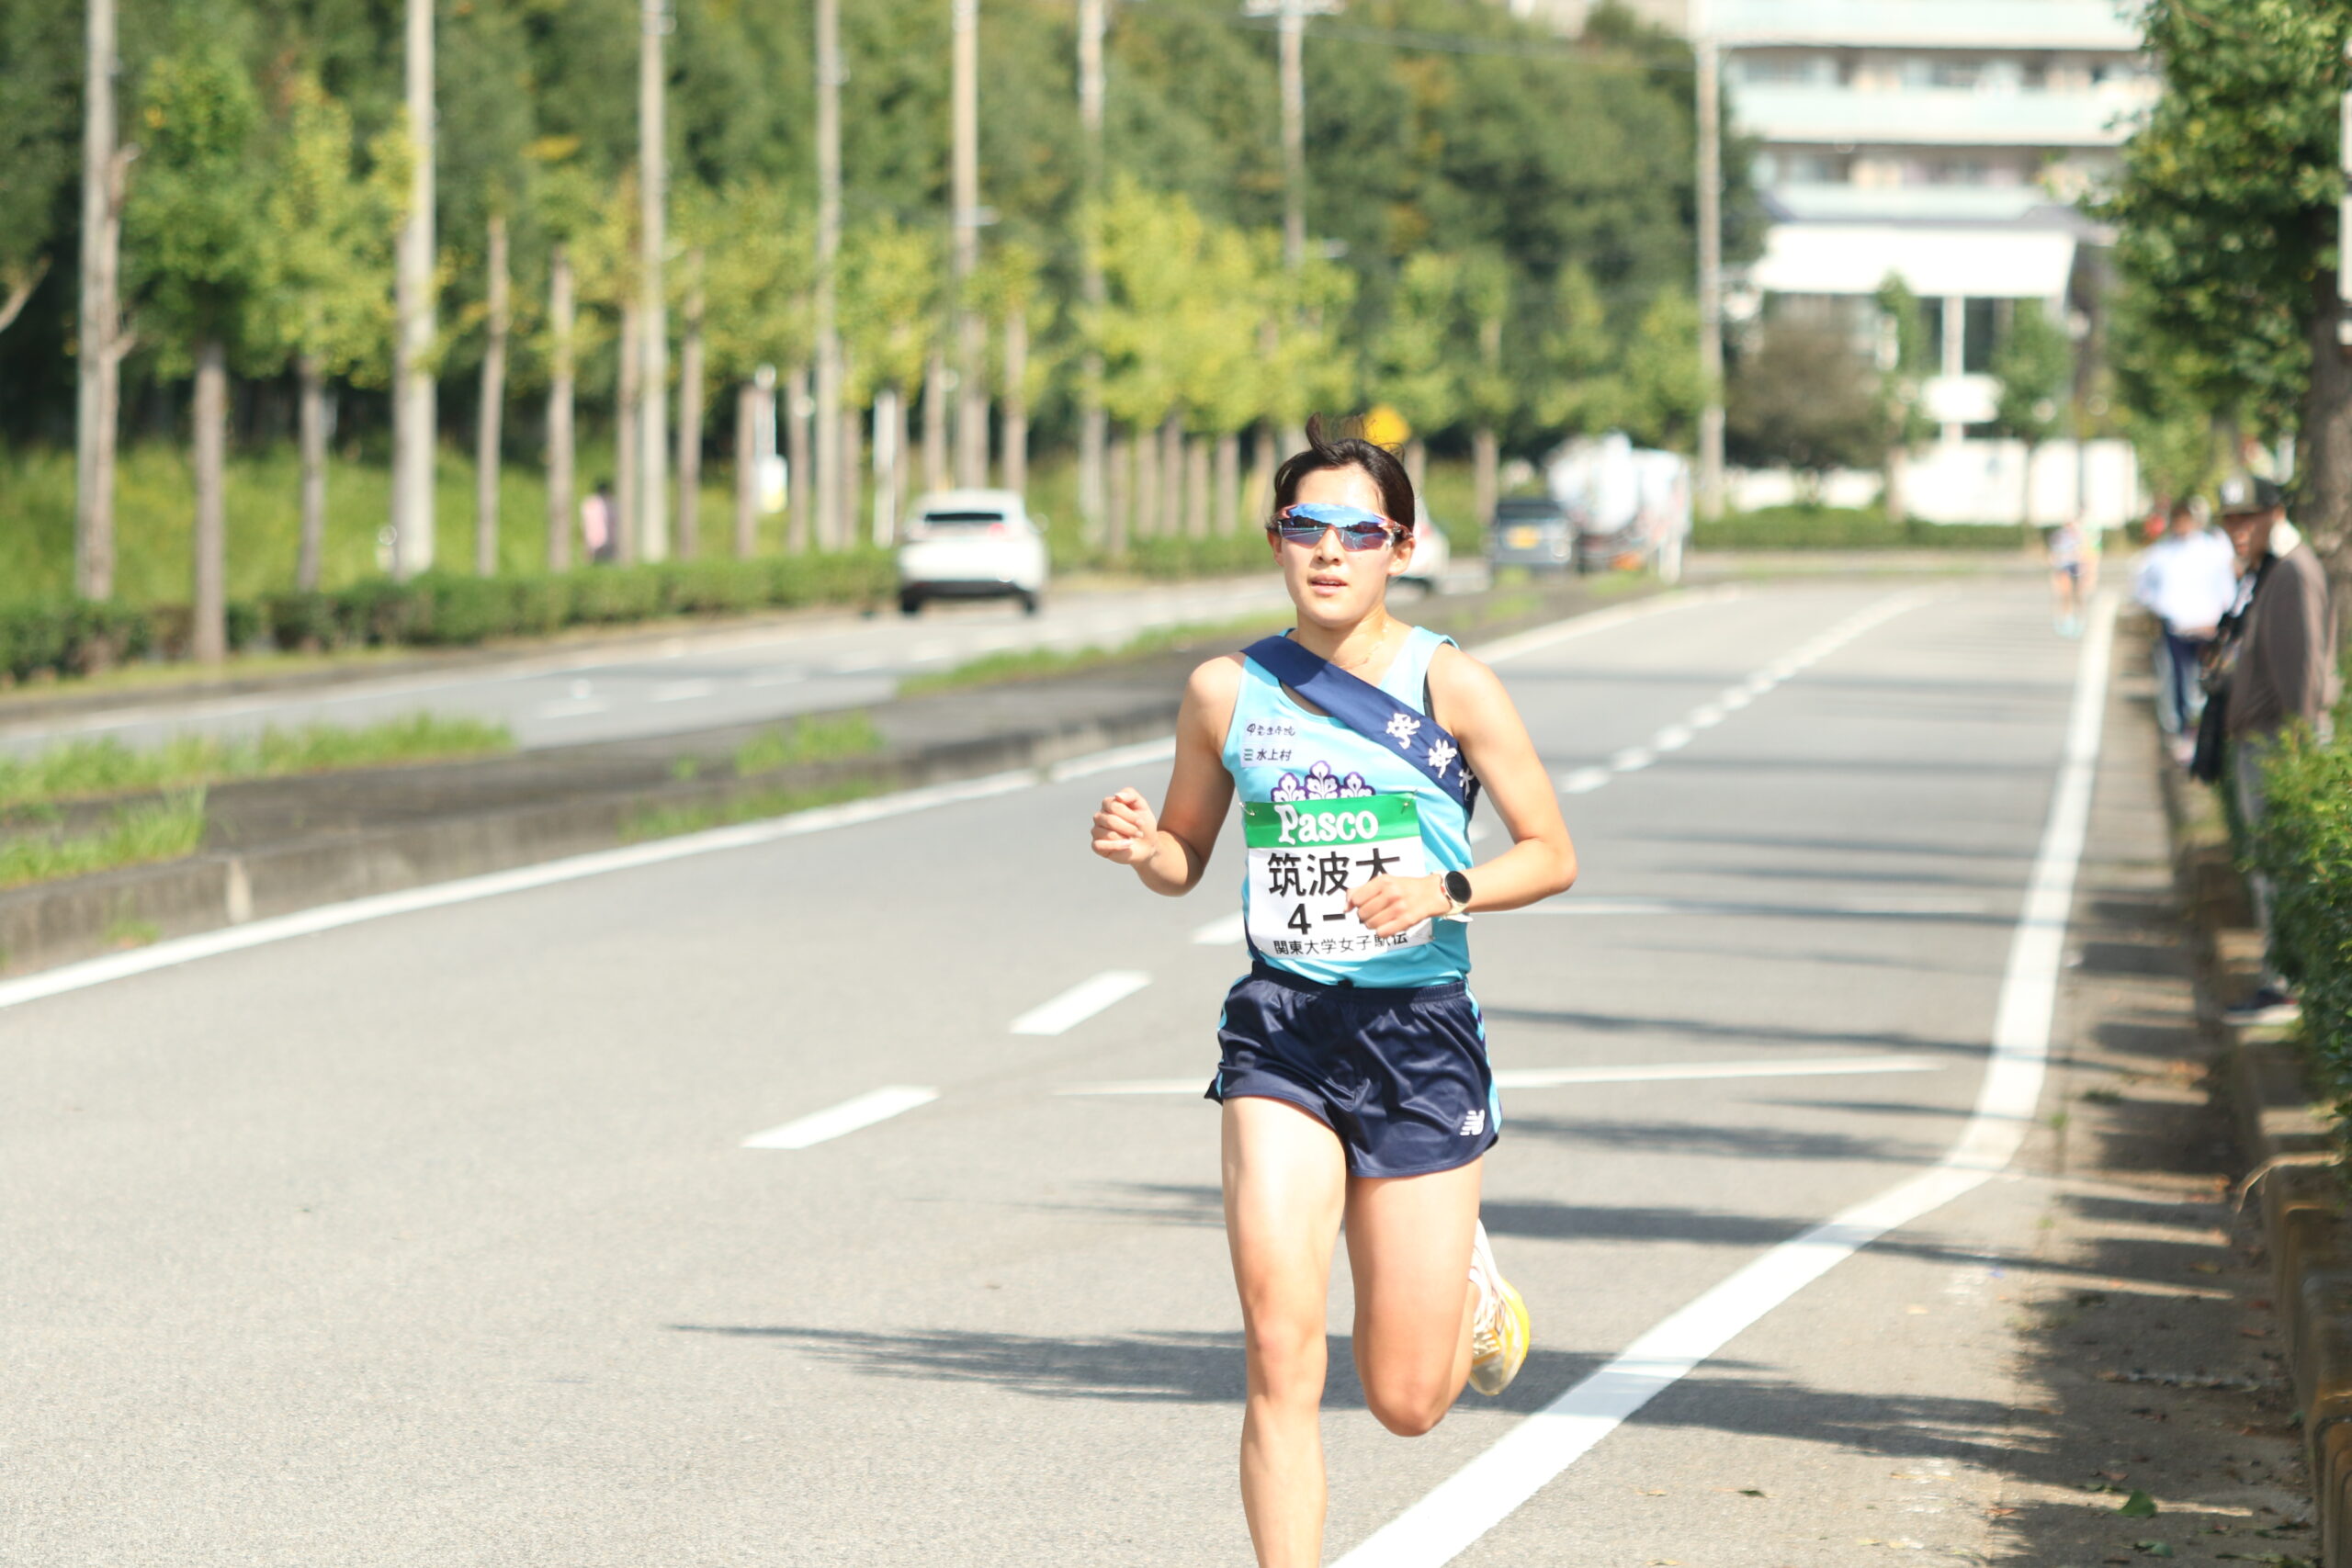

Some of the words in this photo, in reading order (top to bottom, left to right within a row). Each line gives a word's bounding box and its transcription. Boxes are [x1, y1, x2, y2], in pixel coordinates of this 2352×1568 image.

[1257, 749, 1292, 761] 水上村
[1274, 805, 1379, 845] Pasco
[1268, 848, 1401, 897] 筑波大
[1273, 933, 1408, 955] 関東大学女子駅伝
